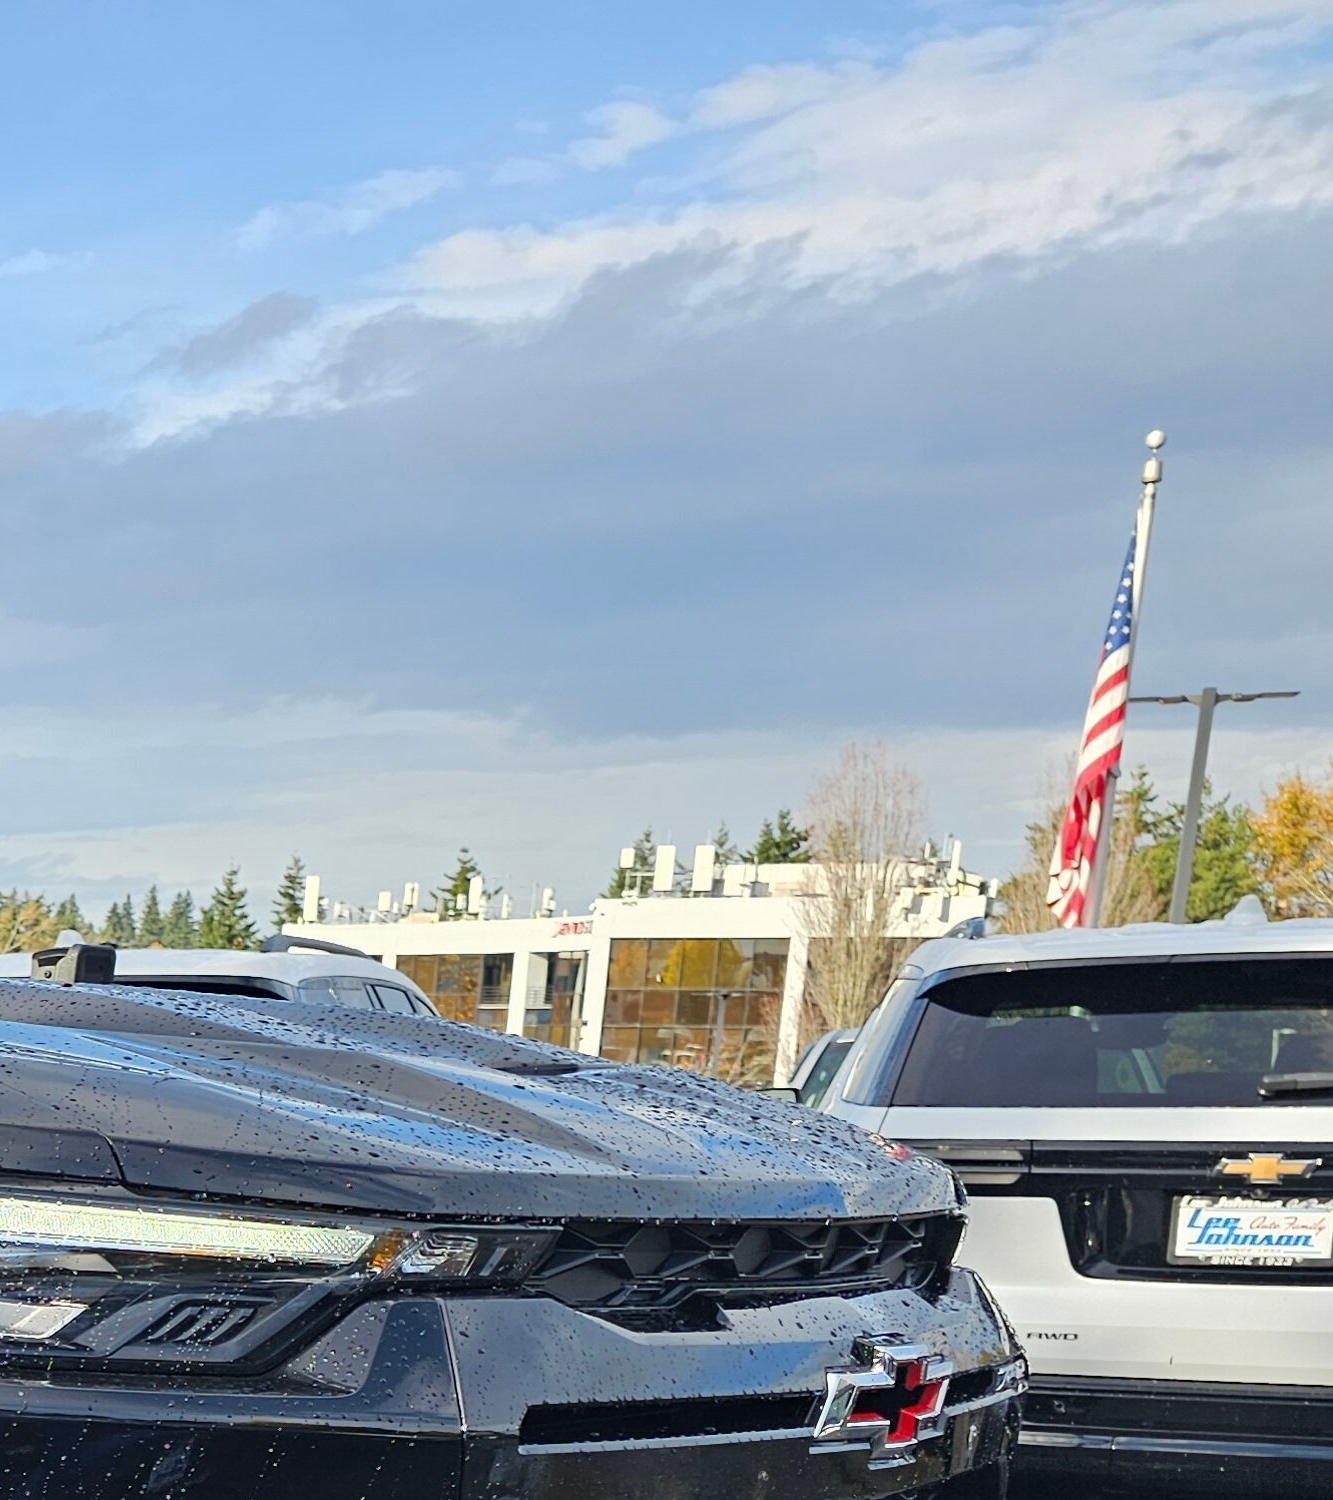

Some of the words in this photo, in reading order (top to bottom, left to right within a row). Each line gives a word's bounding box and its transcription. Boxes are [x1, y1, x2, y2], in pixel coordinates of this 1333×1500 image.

[1187, 1208, 1243, 1230] Lee
[1249, 1215, 1281, 1230] Auto
[1283, 1215, 1327, 1238] Family
[1187, 1218, 1315, 1248] Johnson
[1026, 1332, 1079, 1341] AWD
